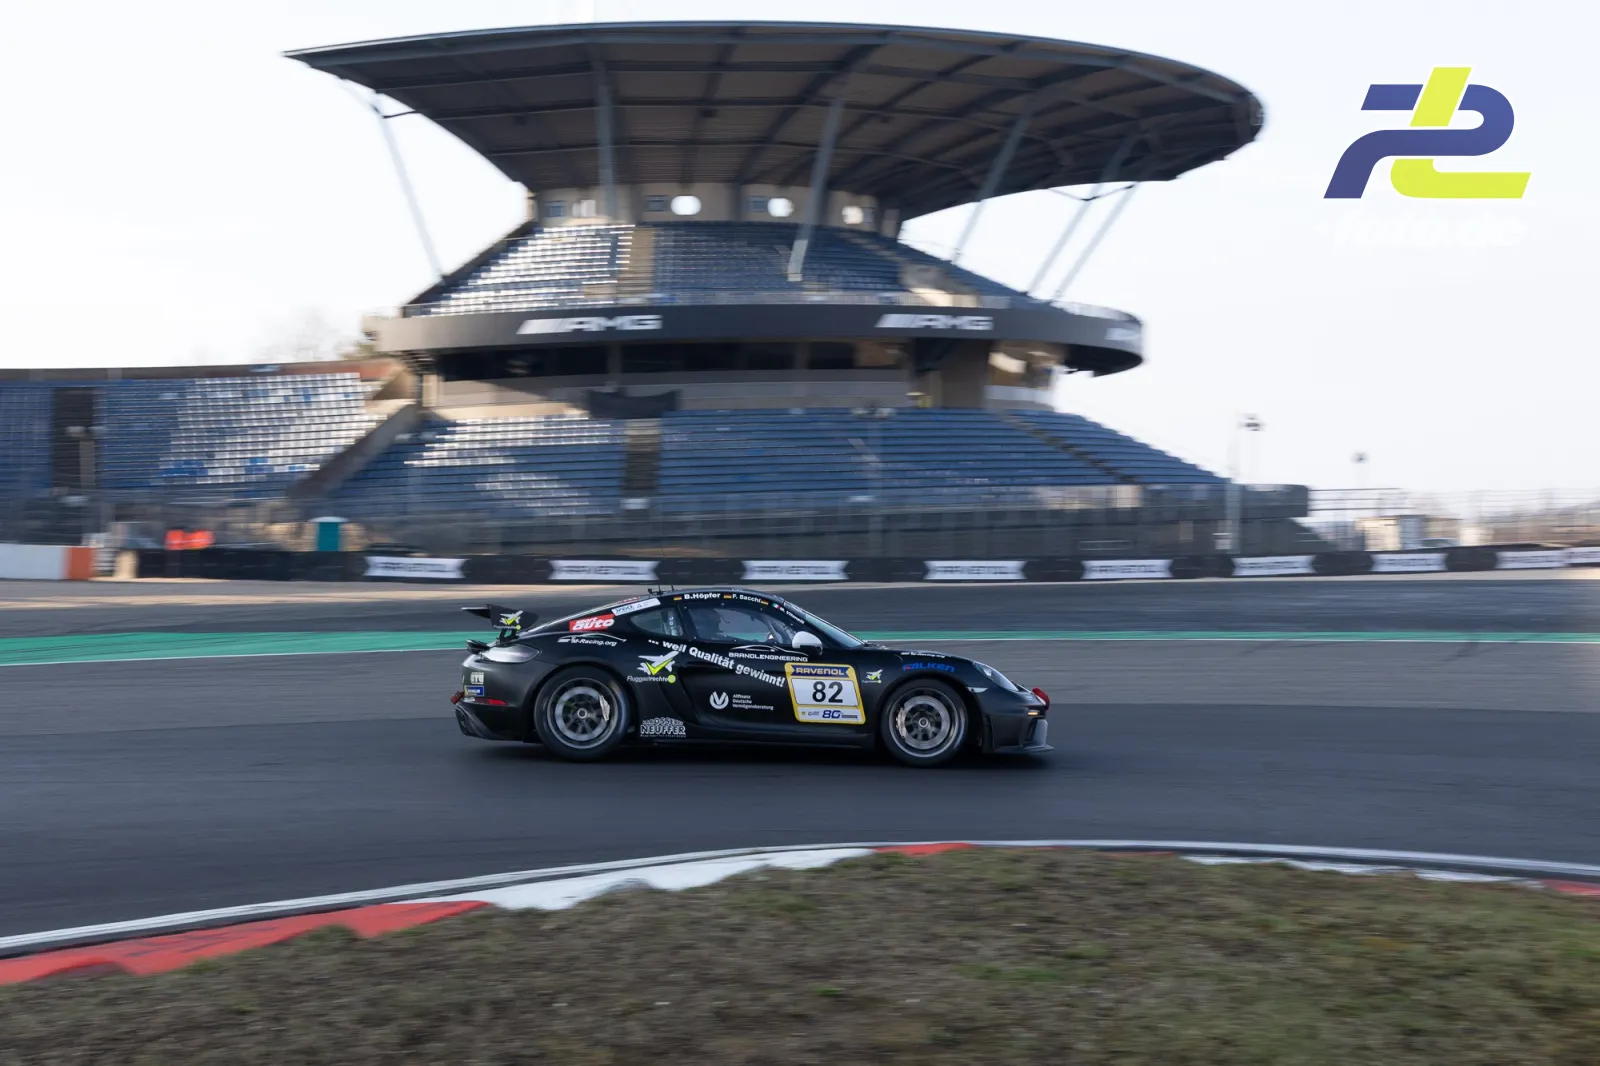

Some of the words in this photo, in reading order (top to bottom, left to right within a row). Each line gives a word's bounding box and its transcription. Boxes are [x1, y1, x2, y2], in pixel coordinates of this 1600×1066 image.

[662, 640, 686, 653] weil
[688, 647, 735, 669] Qualität
[735, 663, 787, 687] gewinnt!
[796, 667, 845, 676] RAVENOL
[812, 680, 843, 703] 82
[640, 724, 686, 734] NEUFFER
